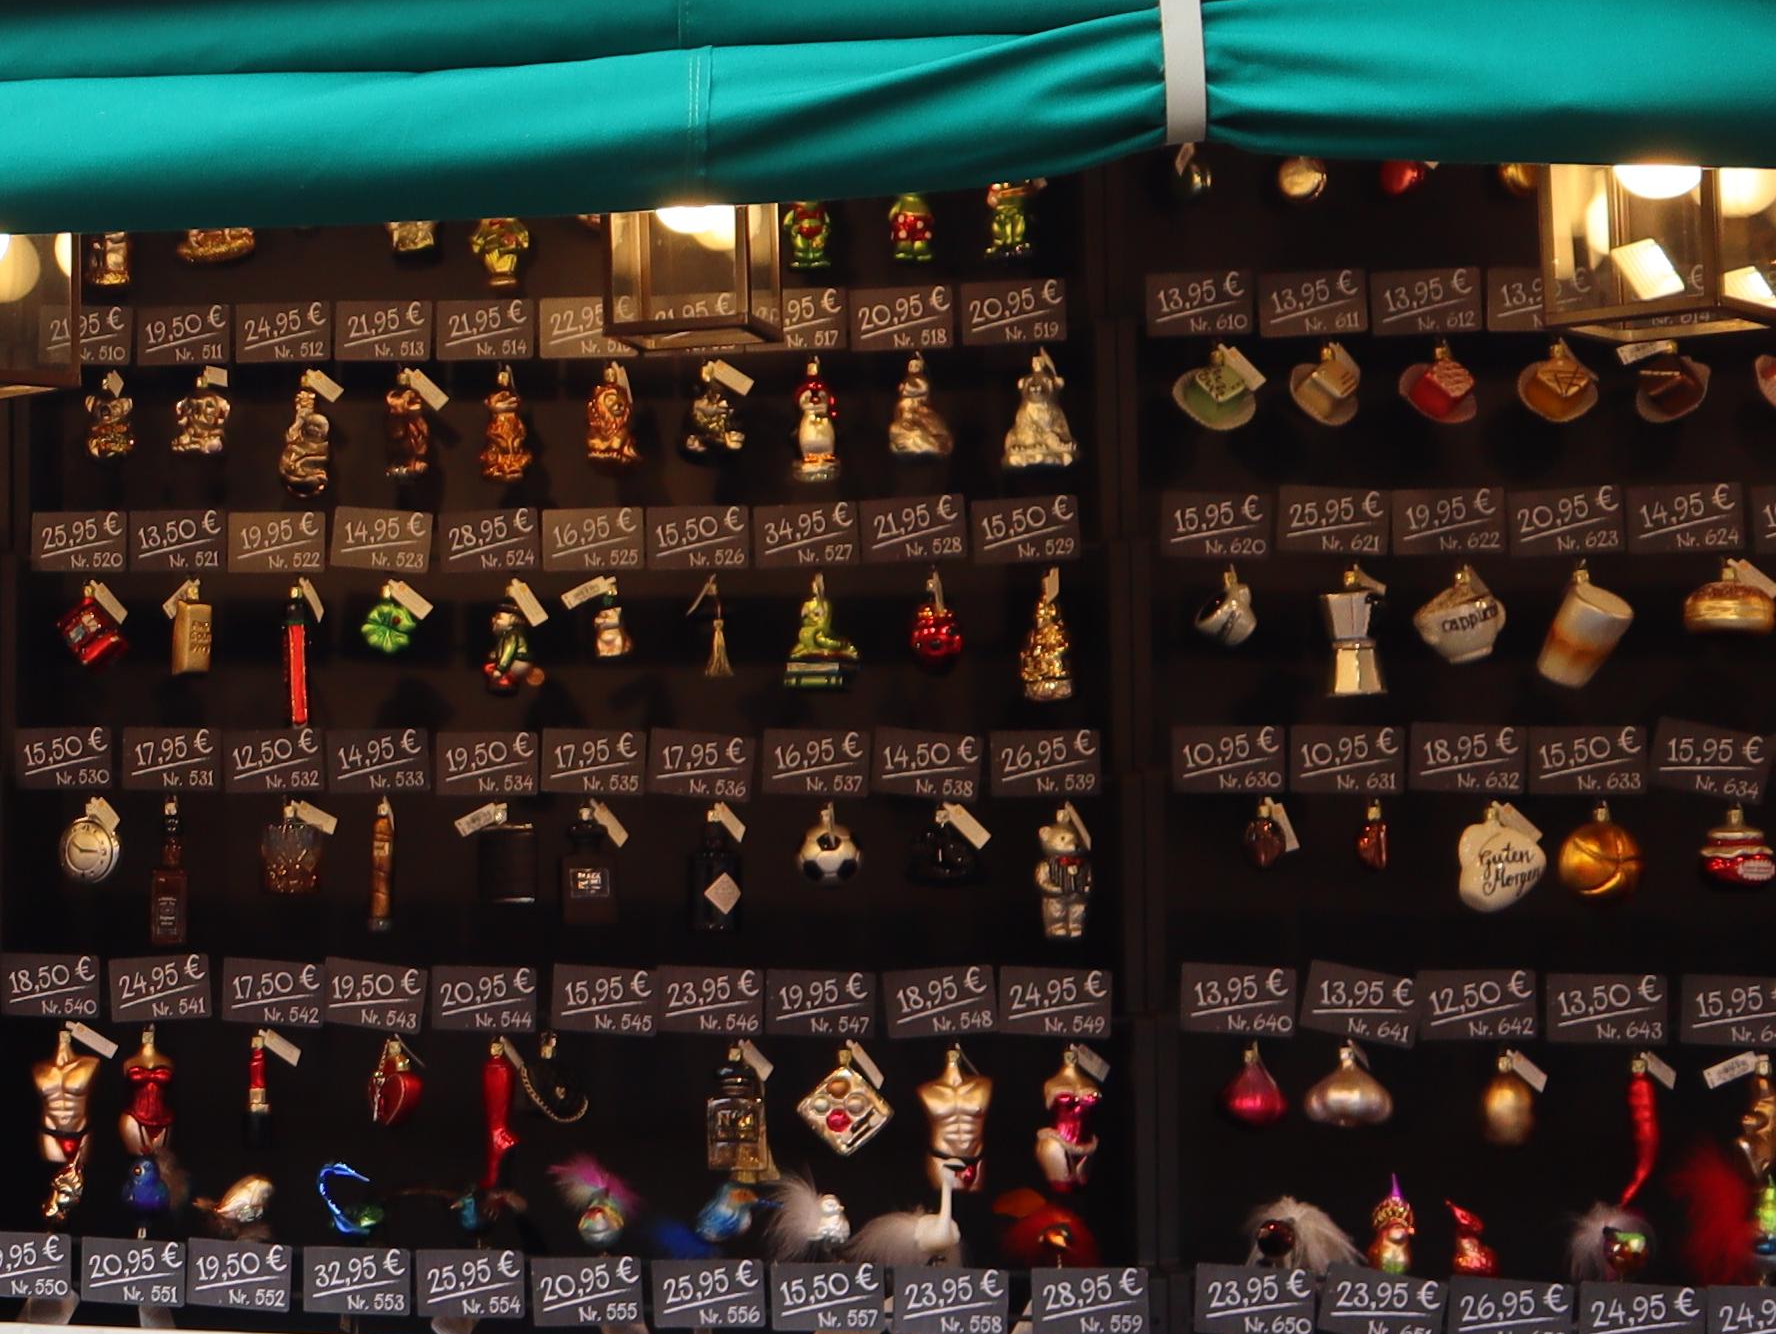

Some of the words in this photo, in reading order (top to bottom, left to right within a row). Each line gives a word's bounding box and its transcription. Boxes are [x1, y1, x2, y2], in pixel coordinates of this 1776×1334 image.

[970, 287, 1034, 323] 20,95
[1042, 279, 1062, 304] €
[1158, 279, 1216, 312] 13,95
[1224, 271, 1244, 297] €
[245, 309, 300, 341] 24,95
[308, 302, 326, 325] €
[1005, 326, 1026, 341] Nr.
[1034, 322, 1058, 338] 519
[1190, 317, 1210, 331] Nr.
[1216, 314, 1247, 330] 610
[274, 345, 293, 358] Nr.
[300, 342, 323, 357] 512
[1517, 494, 1588, 533] 20,95
[1595, 485, 1618, 511] €
[138, 519, 196, 549] 13,50
[202, 510, 221, 534] €
[765, 509, 825, 544] 34,95
[832, 502, 853, 527] €
[1557, 536, 1580, 551] Nr.
[1585, 531, 1618, 548] 623
[169, 554, 188, 567] Nr.
[196, 551, 218, 566] 521
[798, 549, 819, 563] Nr.
[825, 544, 852, 561] 527
[338, 737, 394, 769] 14,95
[401, 729, 421, 753] €
[1424, 733, 1487, 765] 18,95
[1496, 727, 1518, 754] €
[370, 775, 390, 788] Nr.
[396, 771, 424, 787] 533
[1458, 773, 1479, 787] Nr.
[1486, 771, 1519, 789] 632
[119, 962, 178, 999] 24,95
[184, 954, 205, 979] €
[668, 976, 730, 1007] 23,95
[738, 970, 759, 996] €
[152, 1002, 172, 1017] Nr.
[179, 997, 205, 1014] 541
[700, 1015, 721, 1029] Nr.
[726, 1014, 758, 1031] 546
[42, 1235, 64, 1261] €
[11, 1280, 32, 1295] Nr.
[35, 1279, 68, 1295] 550
[1208, 1275, 1278, 1307] 23,95
[1286, 1269, 1310, 1297] €
[1244, 1317, 1268, 1333] Nr.
[1272, 1316, 1311, 1334] 650
